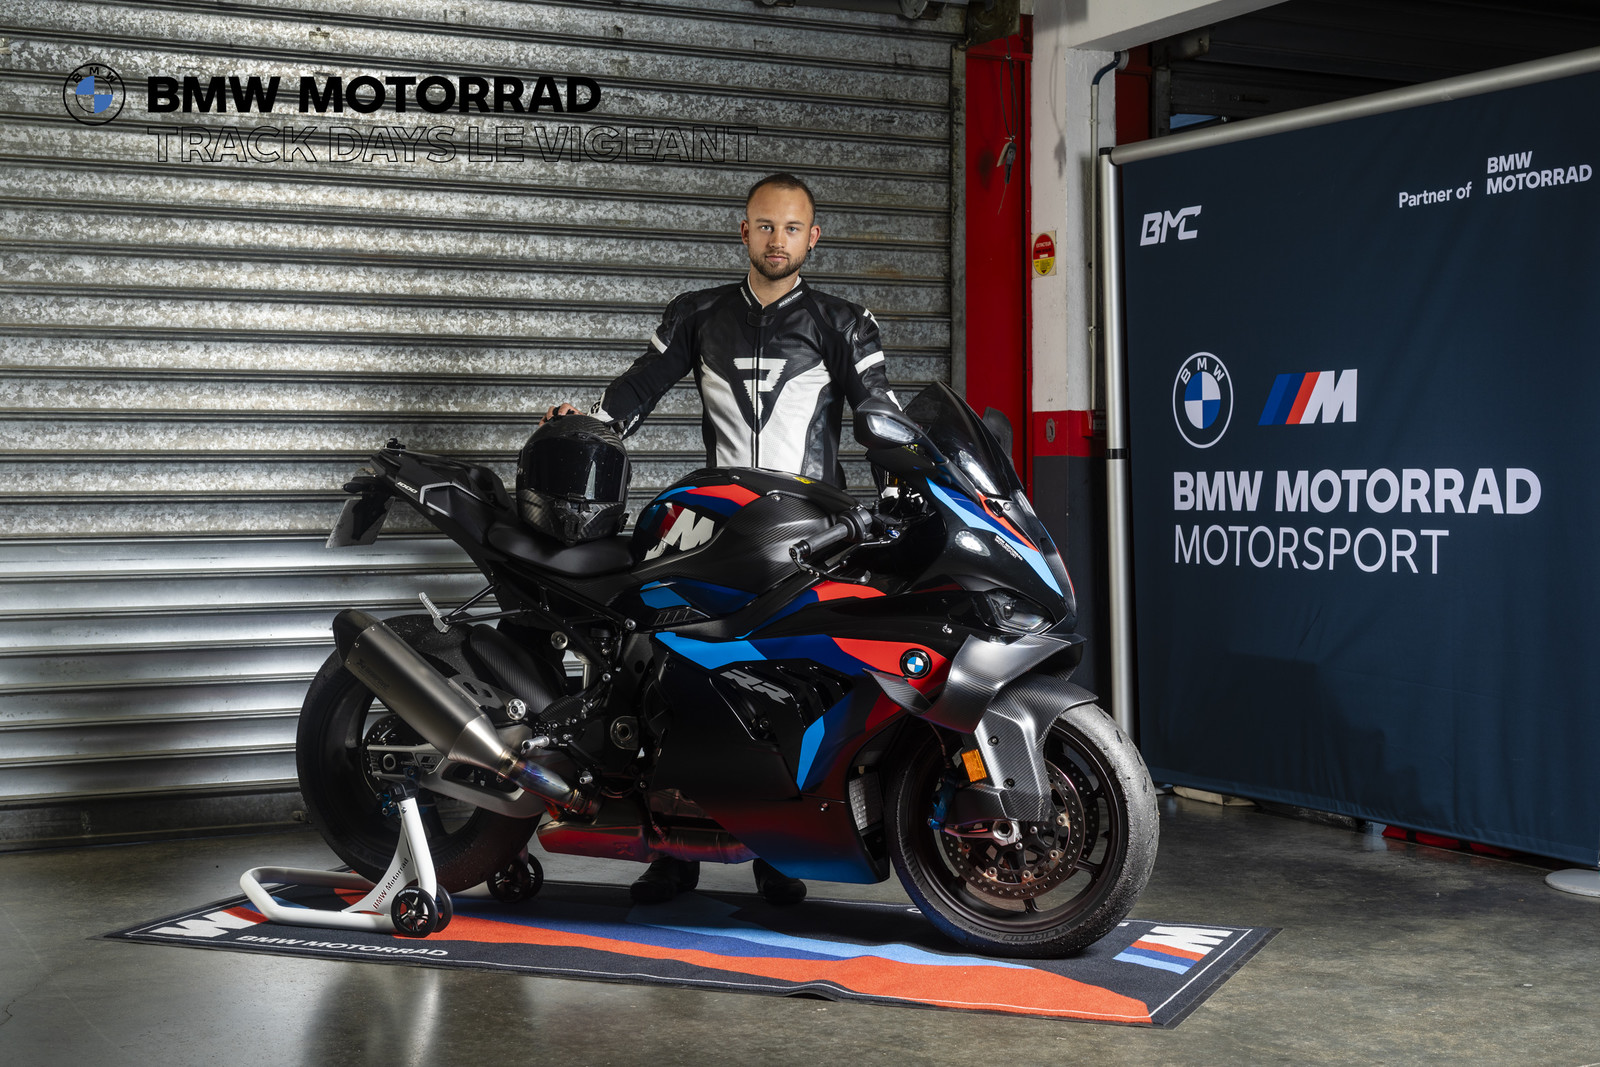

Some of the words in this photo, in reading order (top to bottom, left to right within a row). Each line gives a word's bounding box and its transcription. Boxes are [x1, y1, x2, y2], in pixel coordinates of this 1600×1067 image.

[1486, 150, 1533, 174] BMW
[1398, 188, 1453, 208] Partner
[1455, 181, 1473, 200] of
[1486, 164, 1593, 195] MOTORRAD
[1139, 205, 1203, 247] BMC
[1180, 356, 1225, 385] BMW
[1299, 368, 1358, 425] M
[1173, 470, 1264, 512] BMW
[1274, 468, 1542, 515] MOTORRAD
[1174, 524, 1450, 575] MOTORSPORT
[372, 889, 387, 910] BMW
[385, 857, 409, 891] Motorrad
[236, 934, 304, 946] BMW
[300, 940, 449, 957] MOTORRAD
[1003, 929, 1057, 942] MICHELIN
